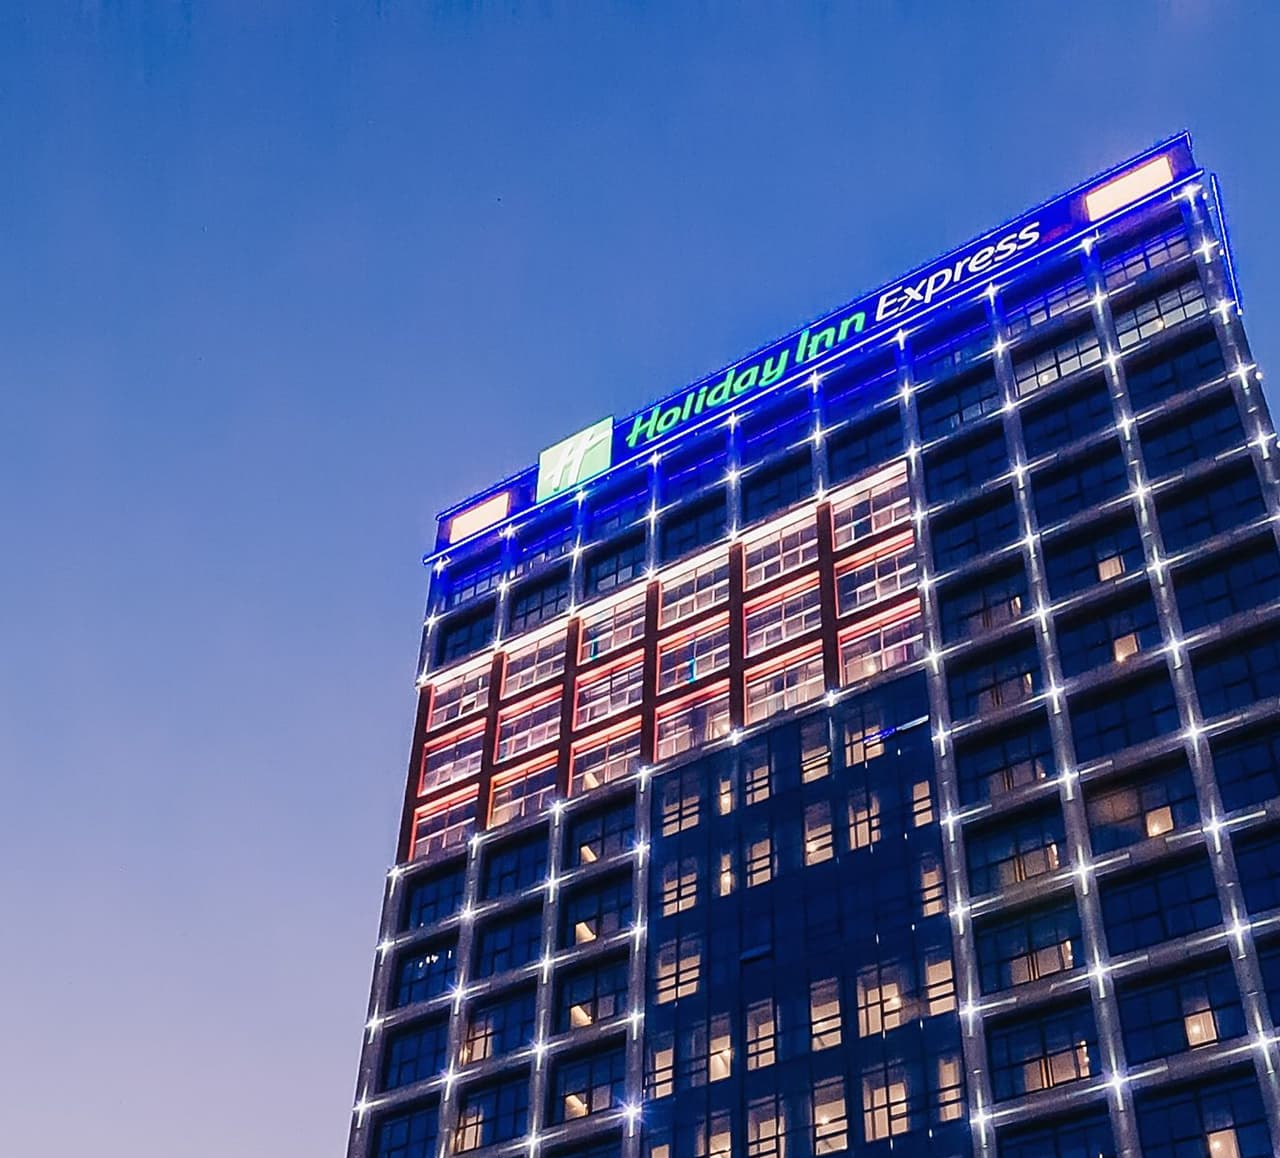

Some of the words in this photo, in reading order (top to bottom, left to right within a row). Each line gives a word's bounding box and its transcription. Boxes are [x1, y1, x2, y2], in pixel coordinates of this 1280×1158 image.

[626, 349, 789, 448] Holiday
[795, 311, 866, 364] Inn
[875, 221, 1041, 322] Express
